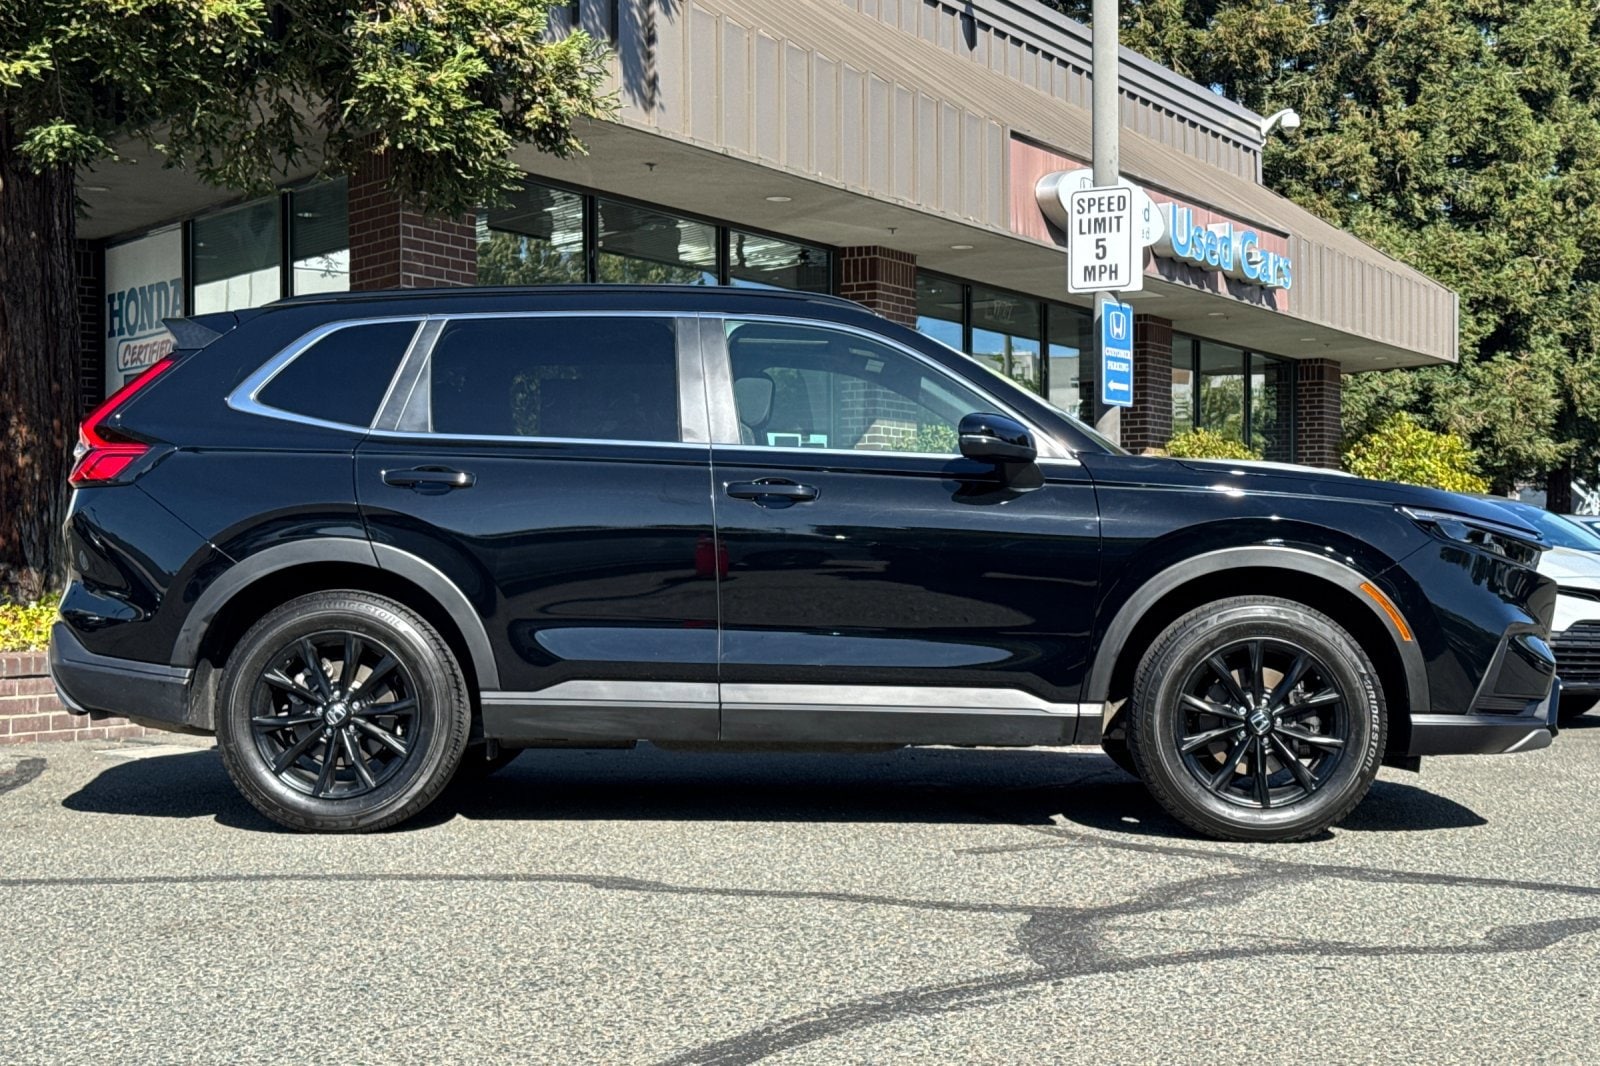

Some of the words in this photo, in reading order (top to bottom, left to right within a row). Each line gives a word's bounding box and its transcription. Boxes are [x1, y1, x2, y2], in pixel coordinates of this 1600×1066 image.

[1076, 195, 1127, 215] SPEED
[1079, 216, 1124, 235] LIMIT
[1095, 238, 1107, 261] 5
[1170, 202, 1233, 271] Used
[1240, 231, 1292, 289] Cars
[1083, 263, 1118, 282] MPH
[1362, 676, 1380, 774] BRIDGESTONE
